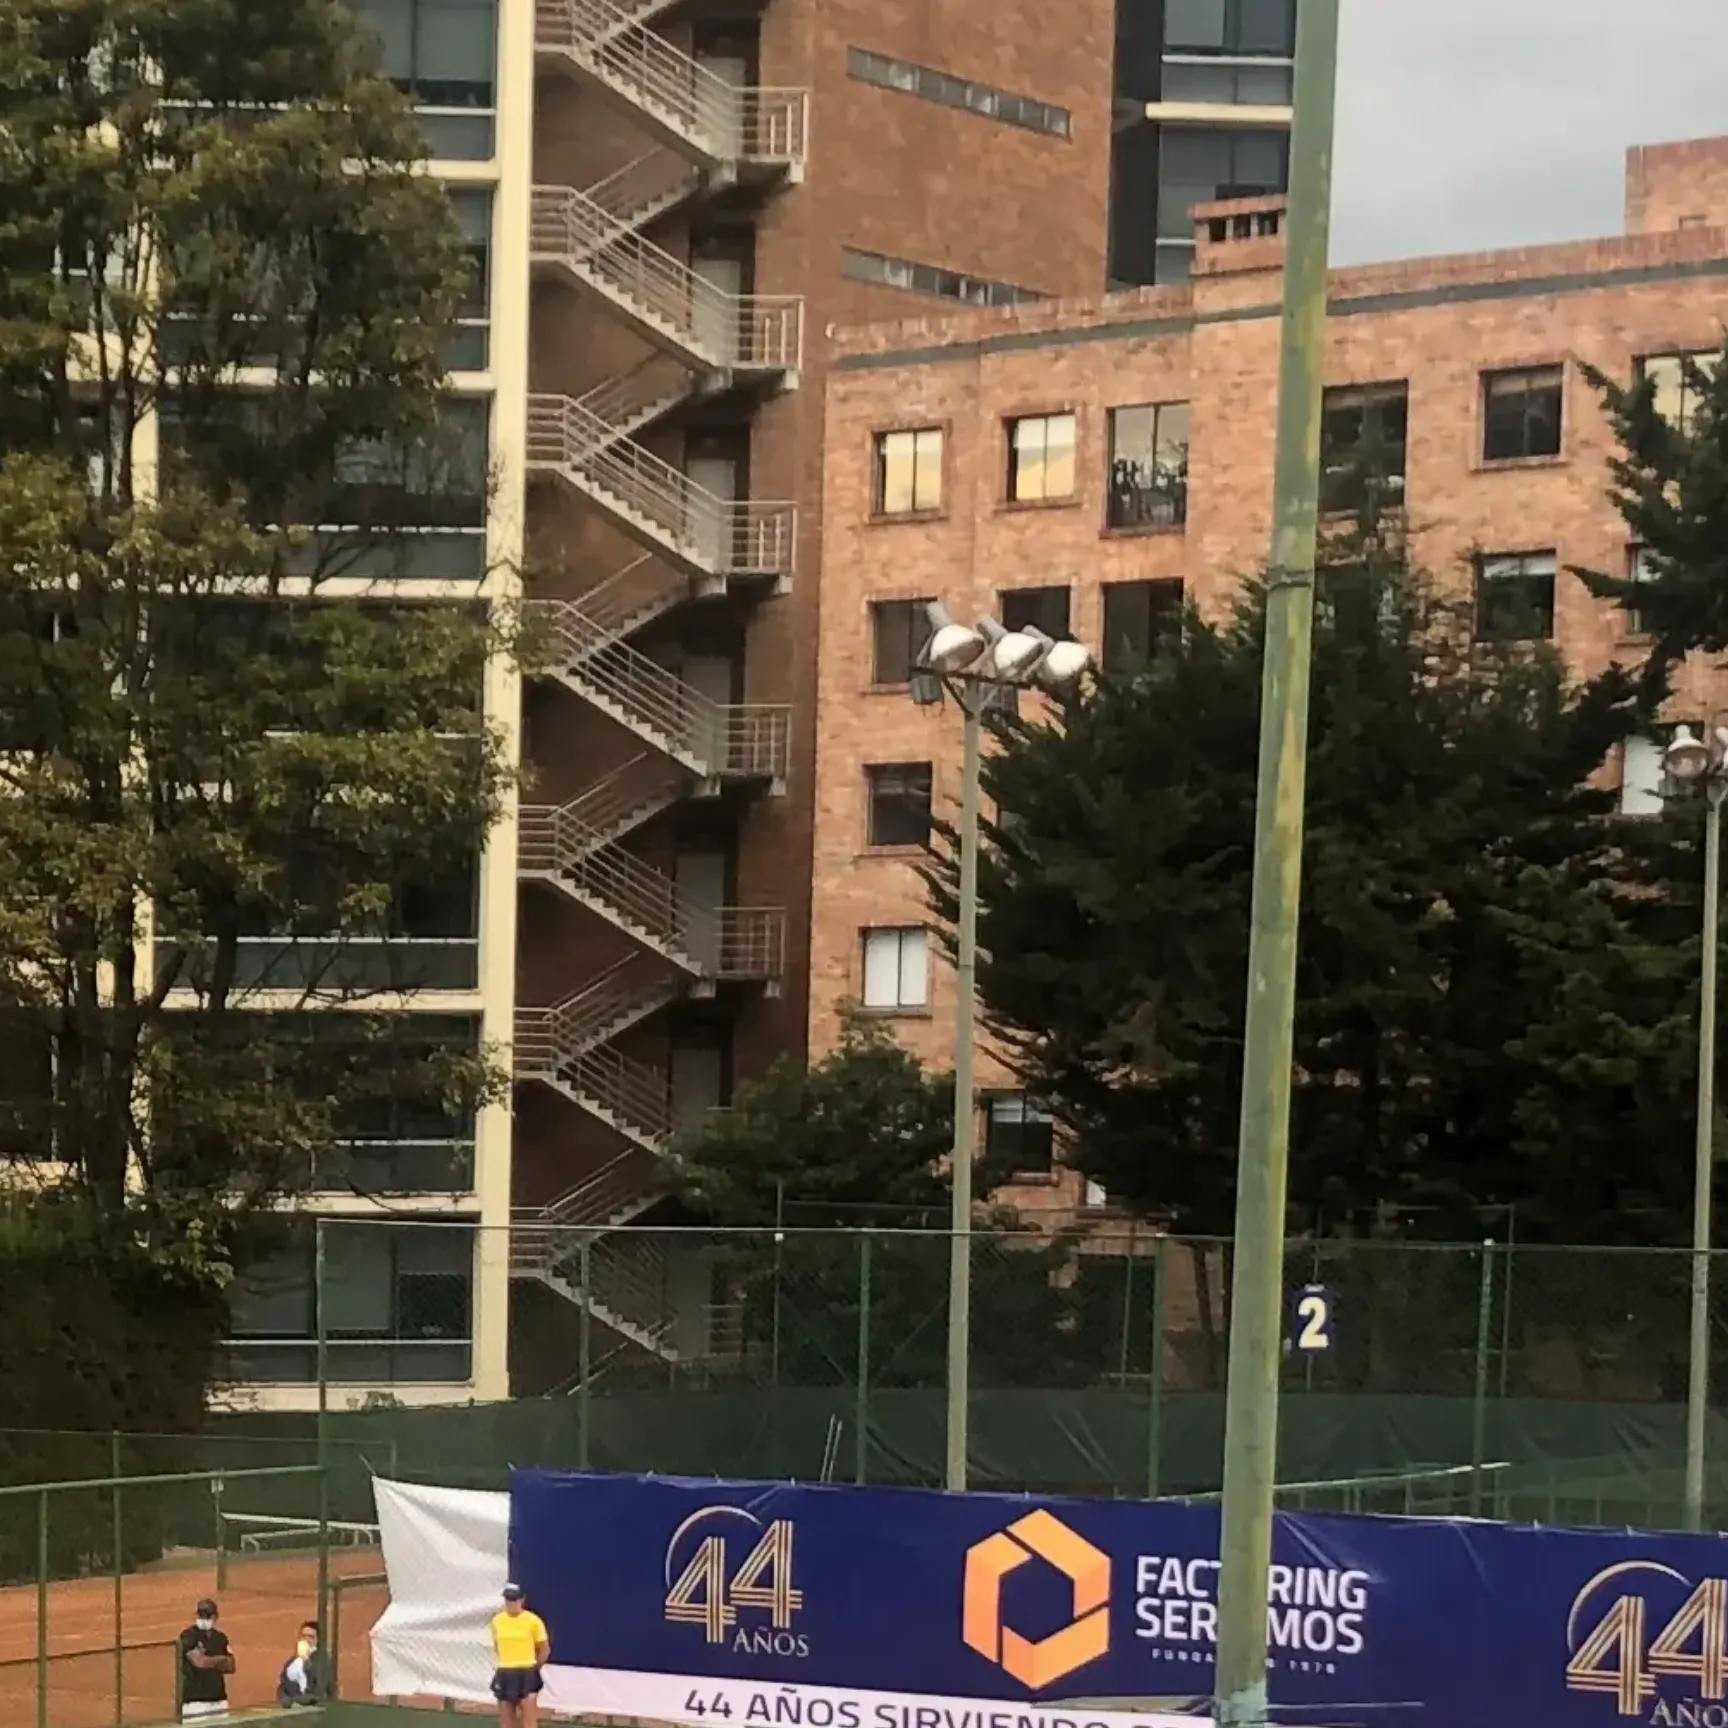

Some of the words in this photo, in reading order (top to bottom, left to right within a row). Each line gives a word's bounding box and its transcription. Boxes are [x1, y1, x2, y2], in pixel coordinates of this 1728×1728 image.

[1298, 1296, 1328, 1349] 2
[665, 1519, 803, 1643] 44
[1136, 1554, 1370, 1610] FACRING
[733, 1626, 810, 1657] AÑOS
[1135, 1597, 1364, 1654] SERMOS
[684, 1689, 733, 1719] 44
[746, 1687, 861, 1728] AÑOS
